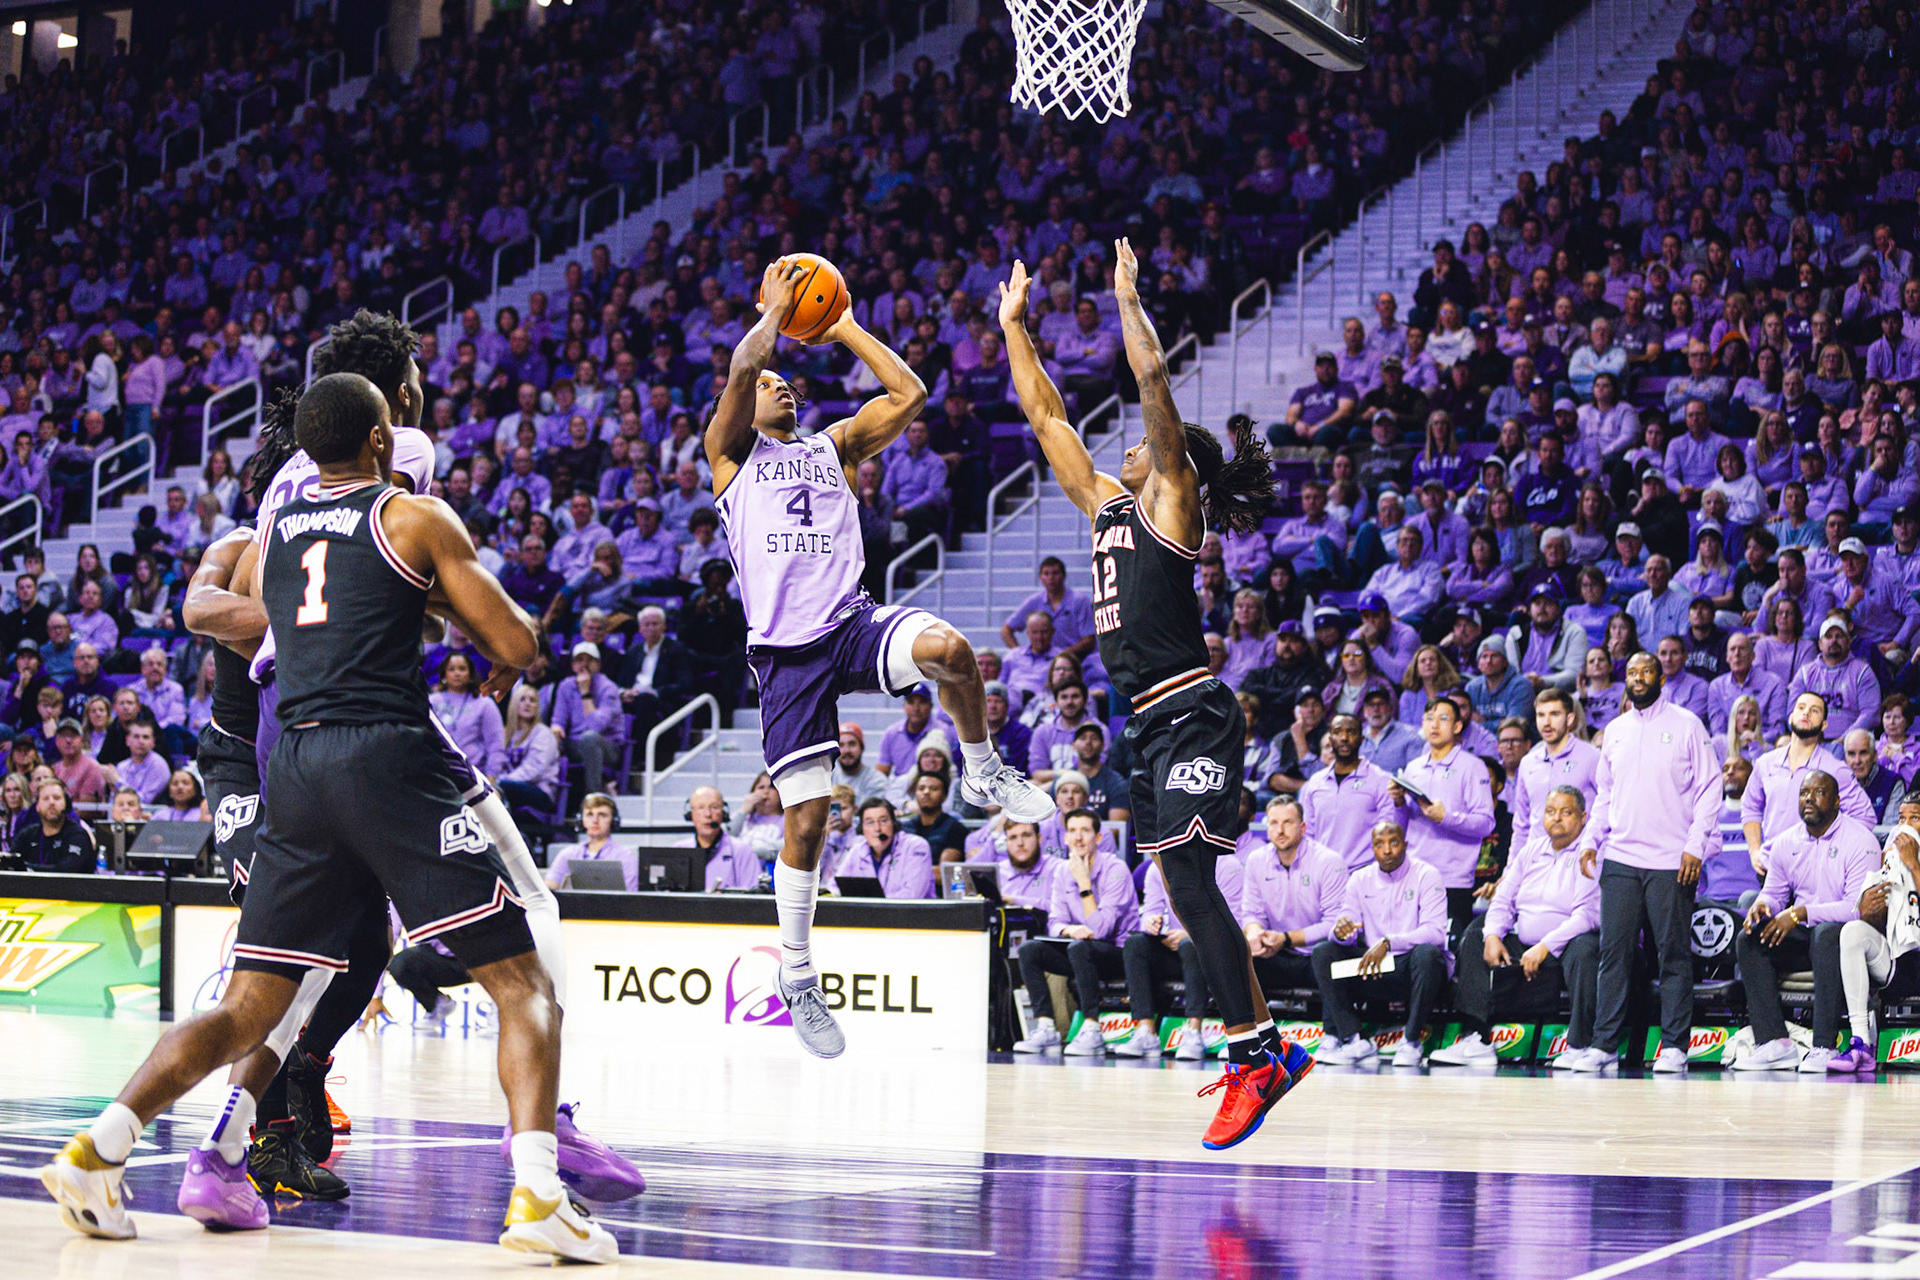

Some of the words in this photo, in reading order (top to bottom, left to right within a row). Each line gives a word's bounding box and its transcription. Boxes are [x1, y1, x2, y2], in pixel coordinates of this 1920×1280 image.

[755, 459, 838, 488] KANSAS
[277, 507, 363, 544] THOMPSON
[786, 489, 813, 527] 4
[766, 532, 832, 554] STATE
[296, 539, 329, 627] 1
[1091, 556, 1118, 604] 12
[1094, 602, 1122, 636] STATE
[1165, 756, 1227, 795] OSU
[440, 804, 490, 856] OS
[594, 964, 712, 1006] TACO
[820, 972, 933, 1014] BELL
[1888, 1032, 1920, 1061] LIB
